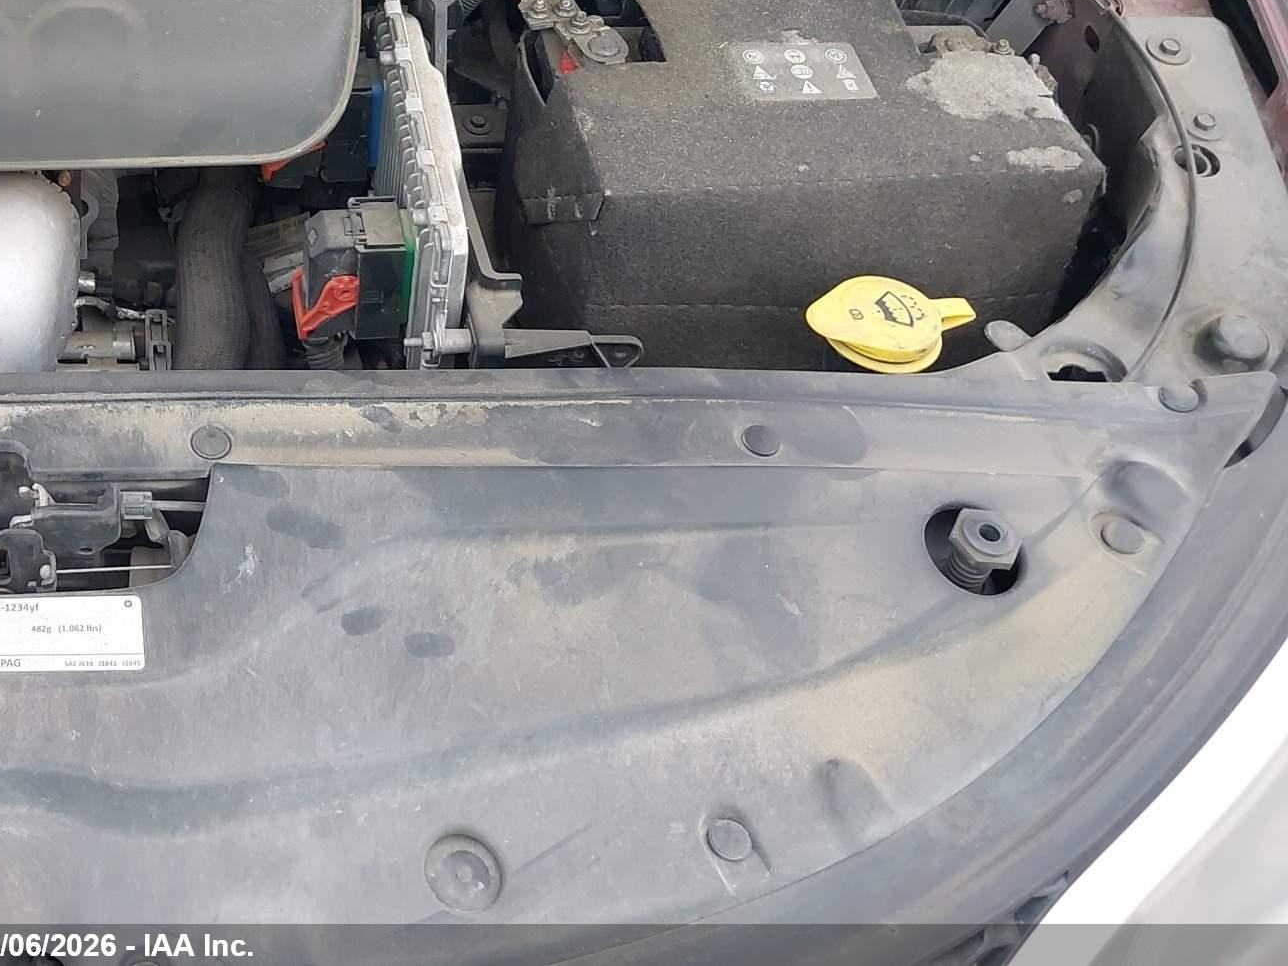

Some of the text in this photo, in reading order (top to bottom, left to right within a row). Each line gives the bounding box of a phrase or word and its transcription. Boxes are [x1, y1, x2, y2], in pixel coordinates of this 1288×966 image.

[31, 624, 102, 634] 482g (1.062 lbs)
[0, 658, 21, 667] PAG
